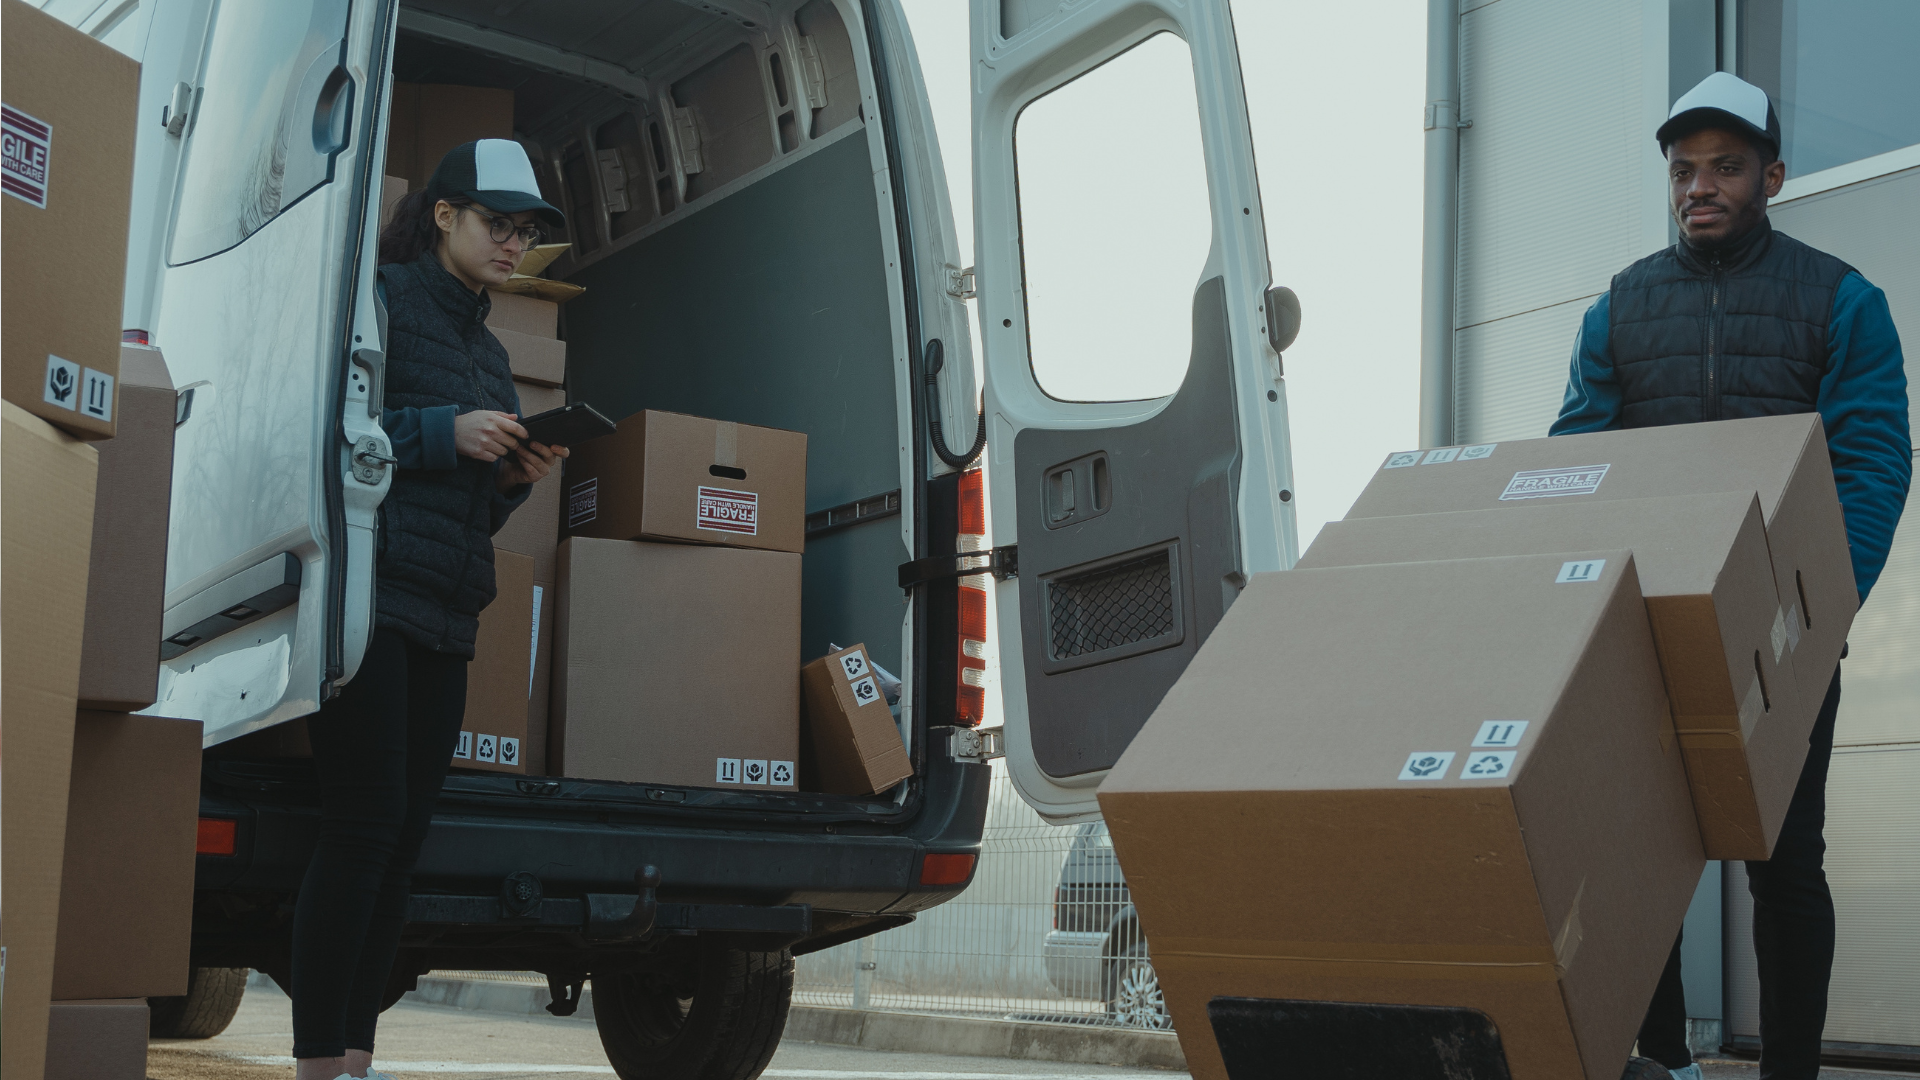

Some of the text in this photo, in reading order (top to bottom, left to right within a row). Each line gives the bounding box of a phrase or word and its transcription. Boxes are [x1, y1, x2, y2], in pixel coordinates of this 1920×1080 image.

[1, 133, 45, 171] GILE
[20, 163, 43, 181] CARE
[1511, 473, 1600, 488] FRAGILE
[571, 496, 596, 515] FRAGILE
[700, 504, 755, 522] FRAGILE
[732, 502, 755, 511] HANDLE
